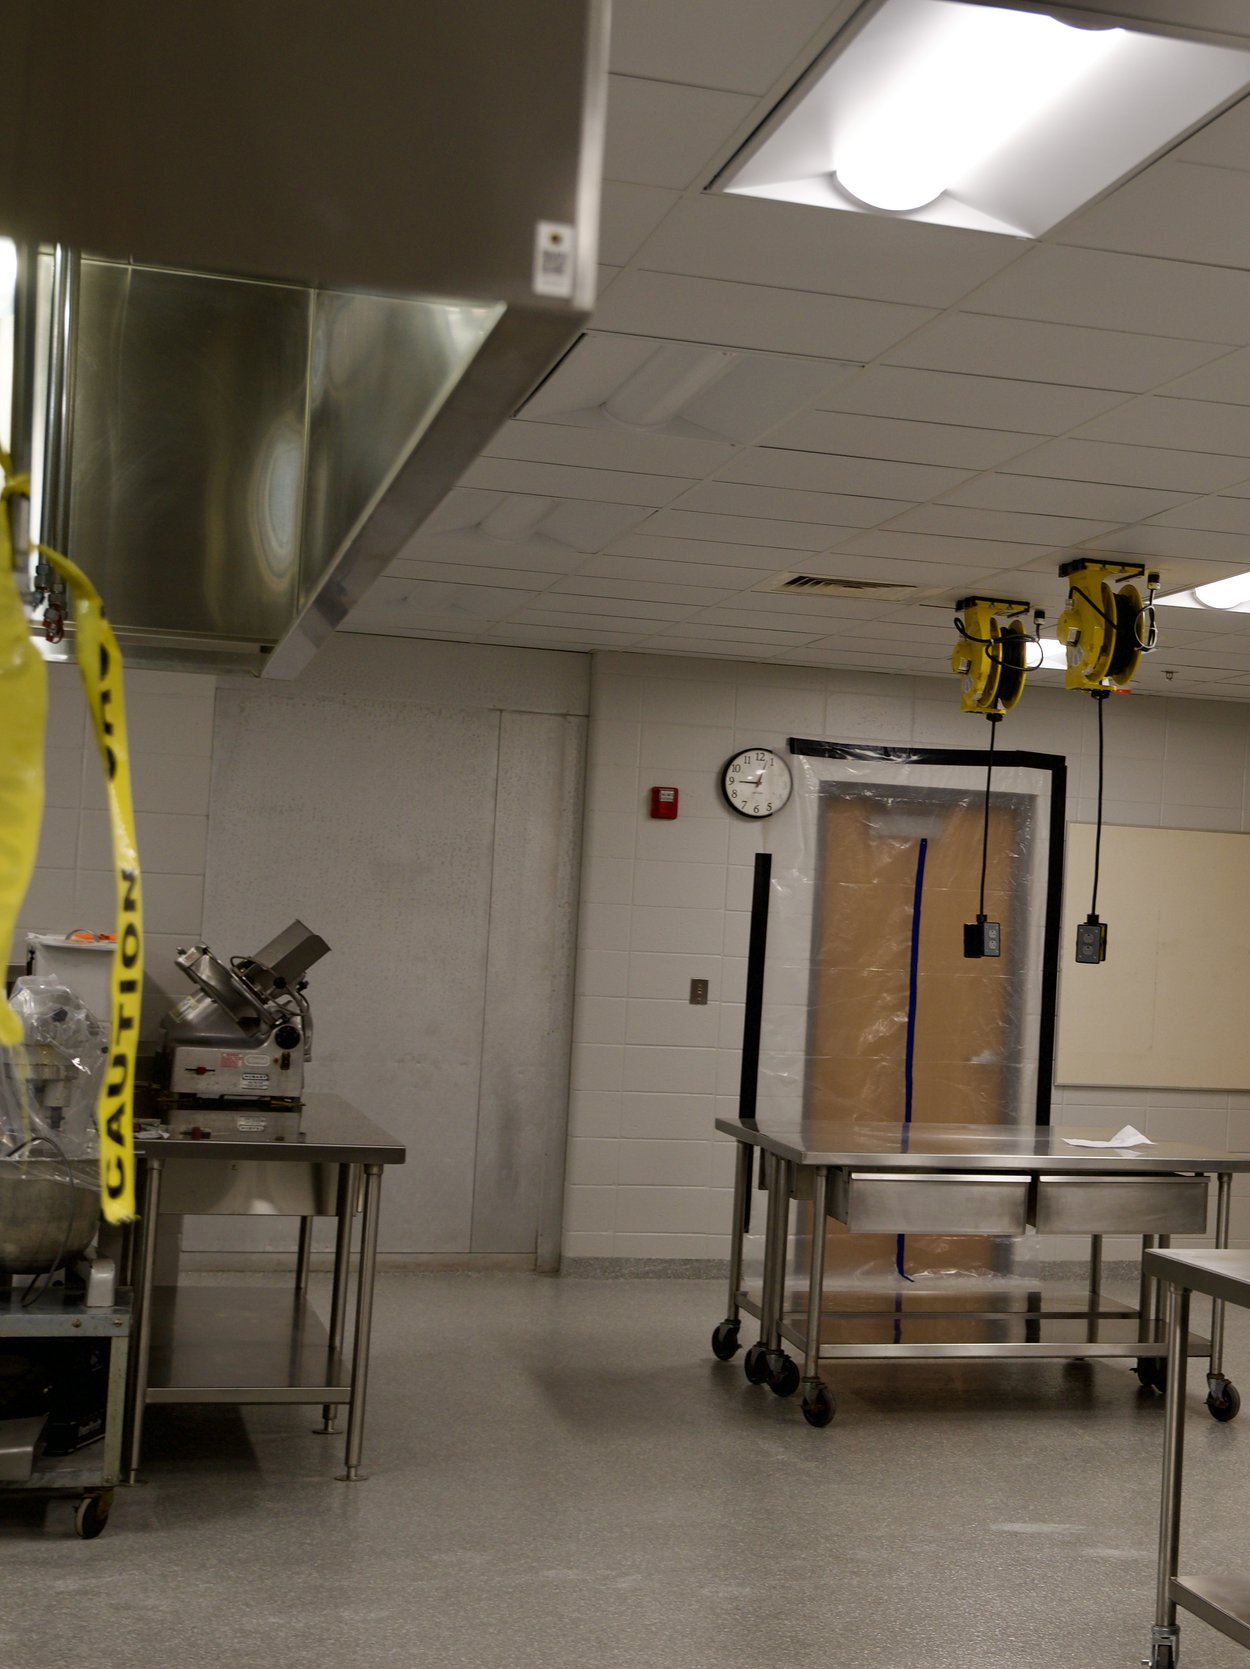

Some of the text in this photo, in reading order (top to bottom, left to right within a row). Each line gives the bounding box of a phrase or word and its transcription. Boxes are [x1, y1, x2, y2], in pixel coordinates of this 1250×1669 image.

[744, 755, 751, 764] 11
[755, 752, 765, 761] 12
[732, 764, 741, 773] 10
[728, 776, 735, 785] 9
[731, 789, 738, 798] 8
[741, 800, 748, 809] 7
[753, 805, 760, 813] 6
[766, 802, 773, 811] 5
[105, 869, 139, 1200] CAUTION
